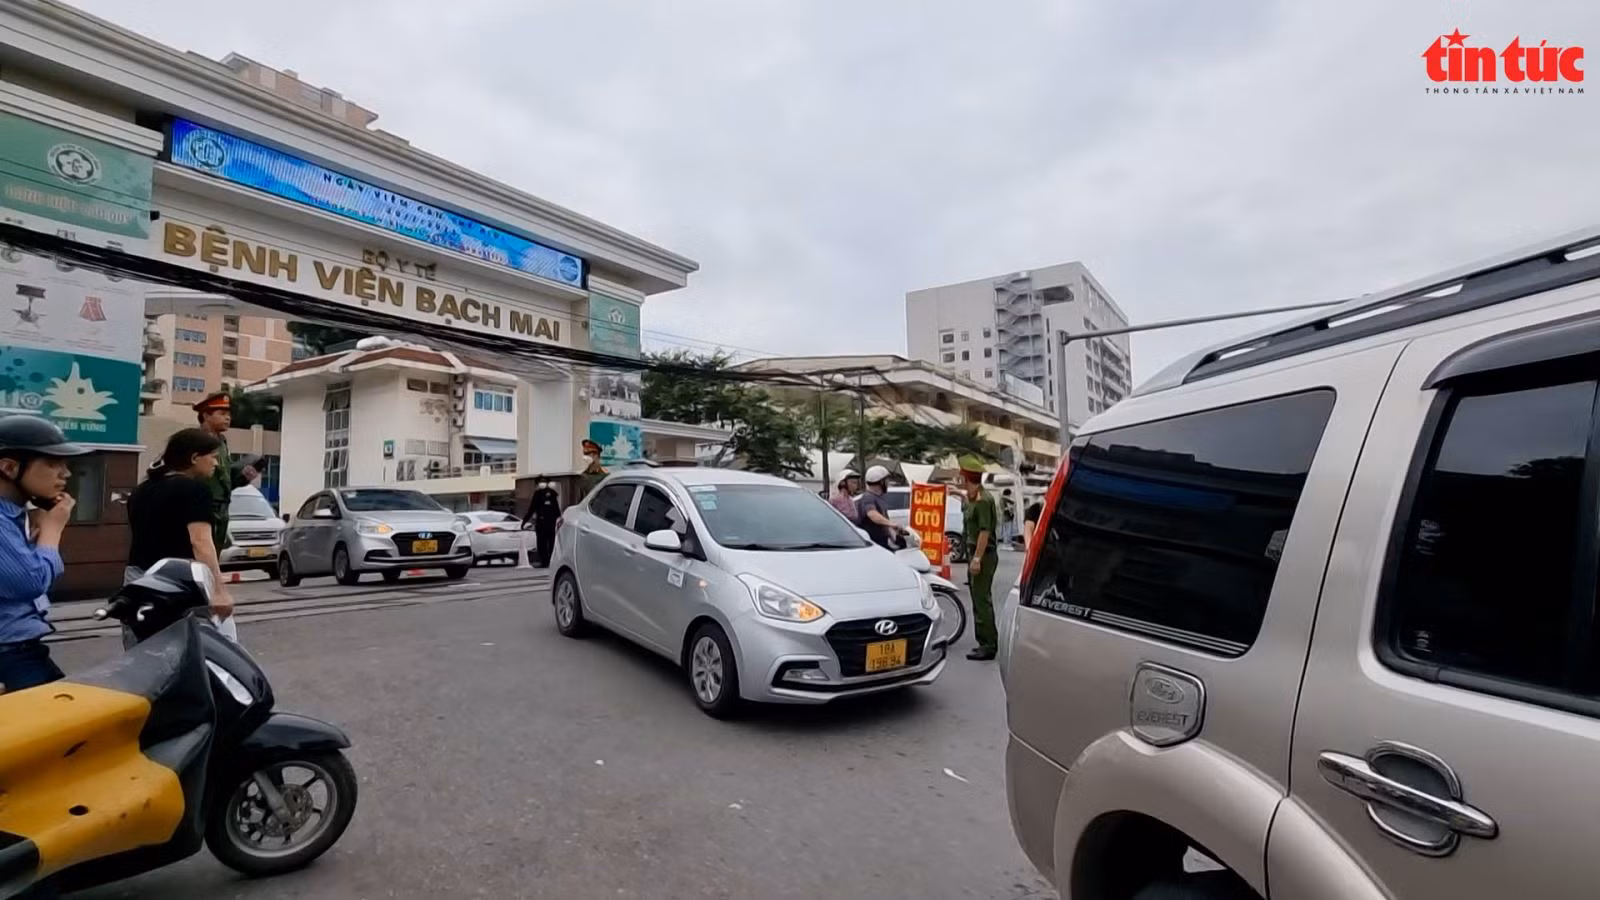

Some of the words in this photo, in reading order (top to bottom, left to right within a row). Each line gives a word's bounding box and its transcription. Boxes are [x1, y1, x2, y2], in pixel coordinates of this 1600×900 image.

[362, 247, 390, 272] BỘ
[396, 258, 409, 273] Y
[413, 261, 438, 281] TẾ
[163, 223, 298, 282] BỆNH
[313, 260, 404, 308] VIỆN
[415, 285, 501, 329] BẠCH
[509, 310, 561, 342] MAI
[1041, 598, 1091, 617] EVEREST
[1136, 710, 1190, 726] EVEREST
